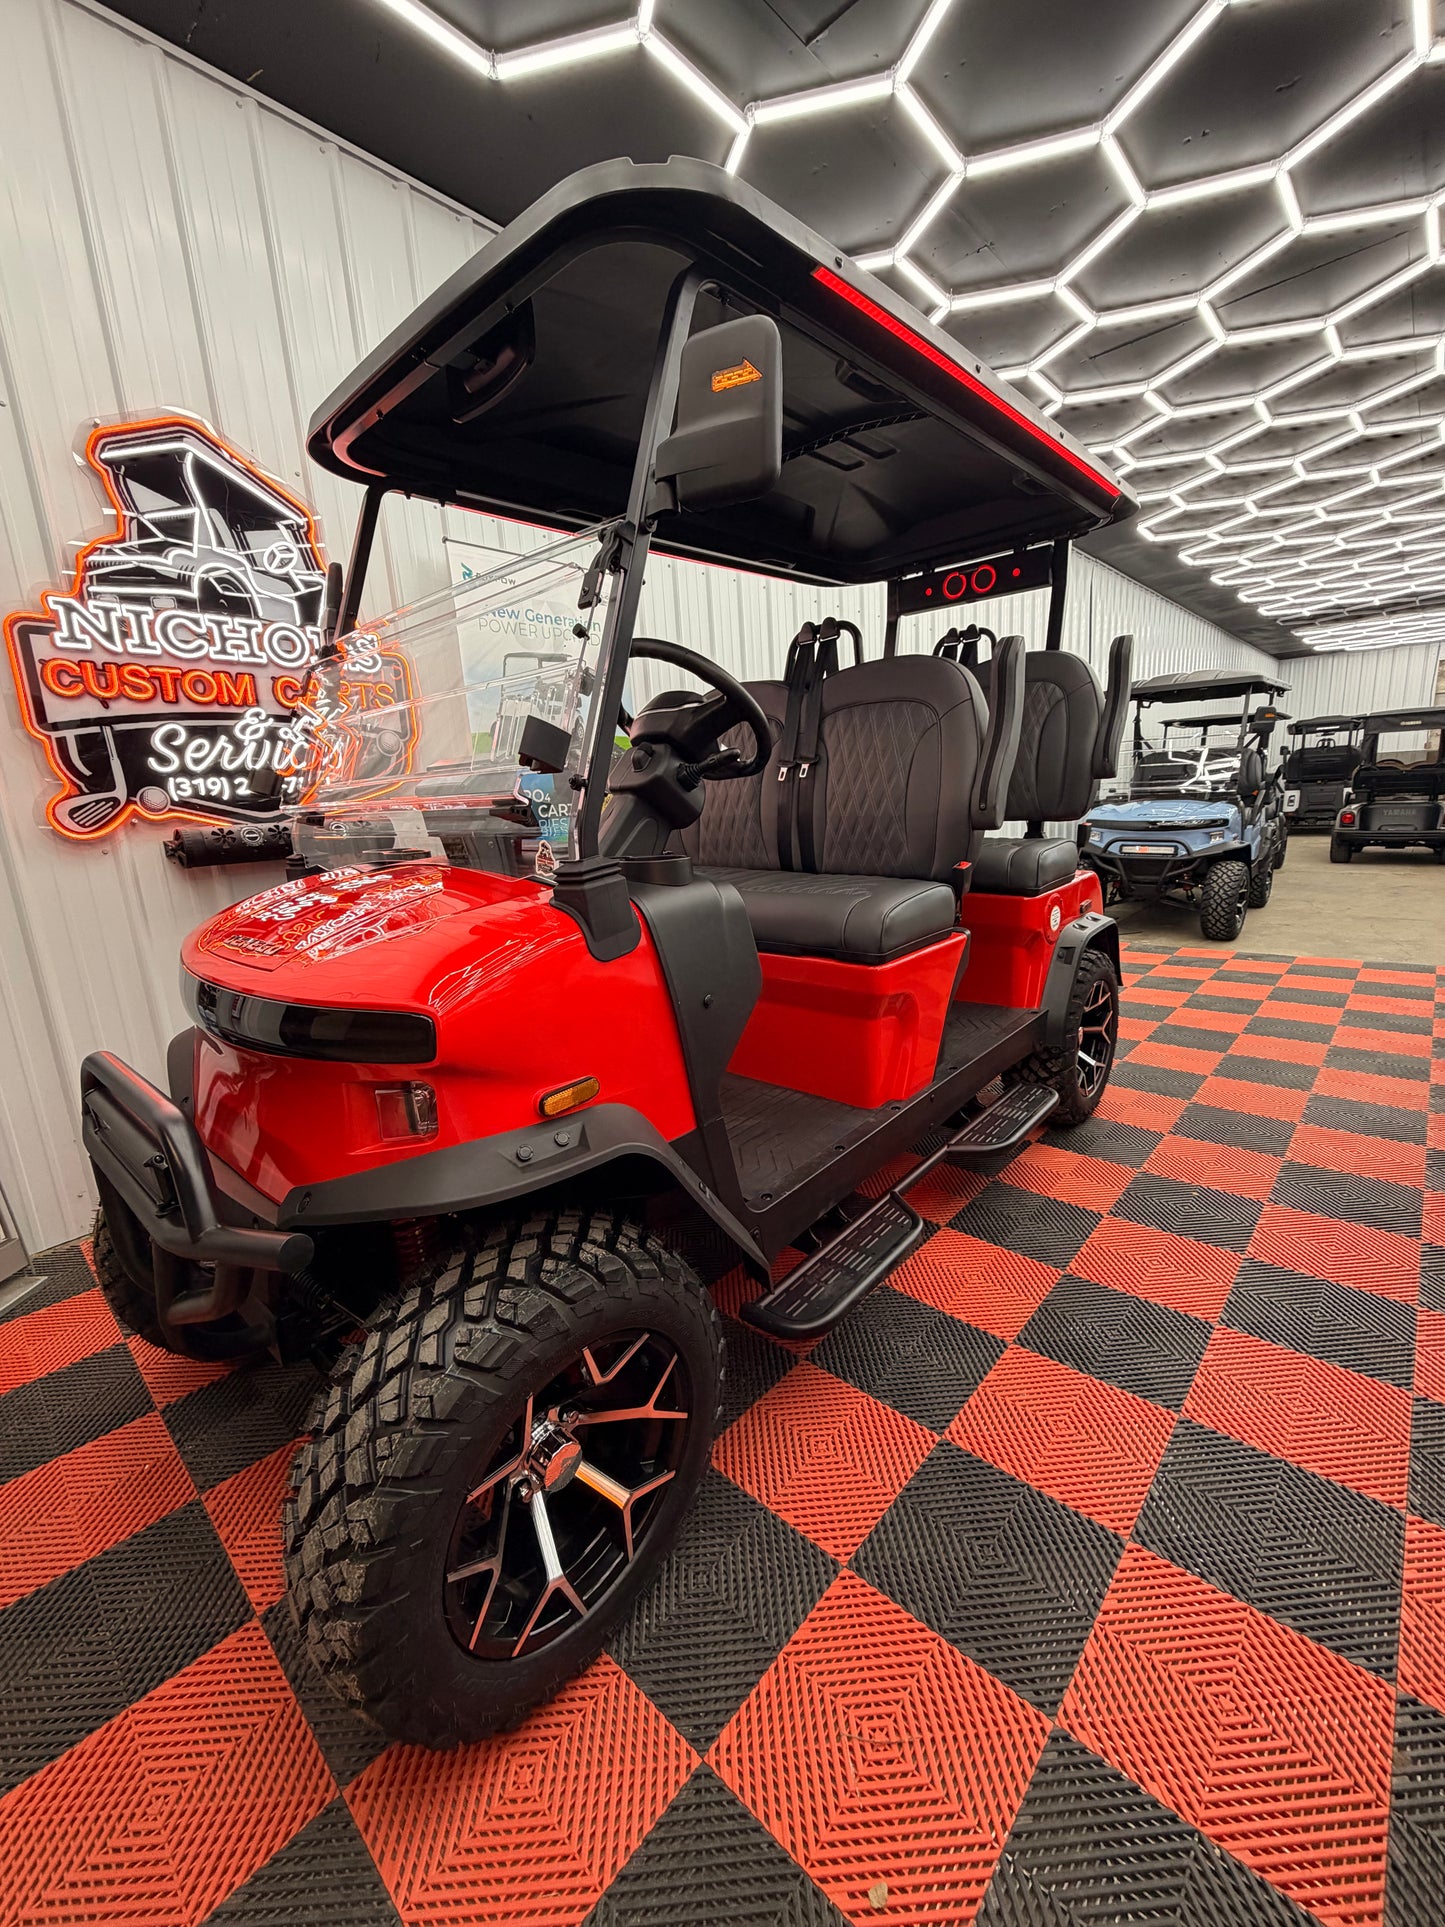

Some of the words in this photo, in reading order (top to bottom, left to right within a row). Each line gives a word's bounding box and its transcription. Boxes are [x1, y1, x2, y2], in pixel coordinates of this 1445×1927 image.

[478, 617, 538, 638] POWER
[41, 658, 257, 707] CUSTOM
[233, 708, 273, 741] &
[168, 776, 229, 801] (319)
